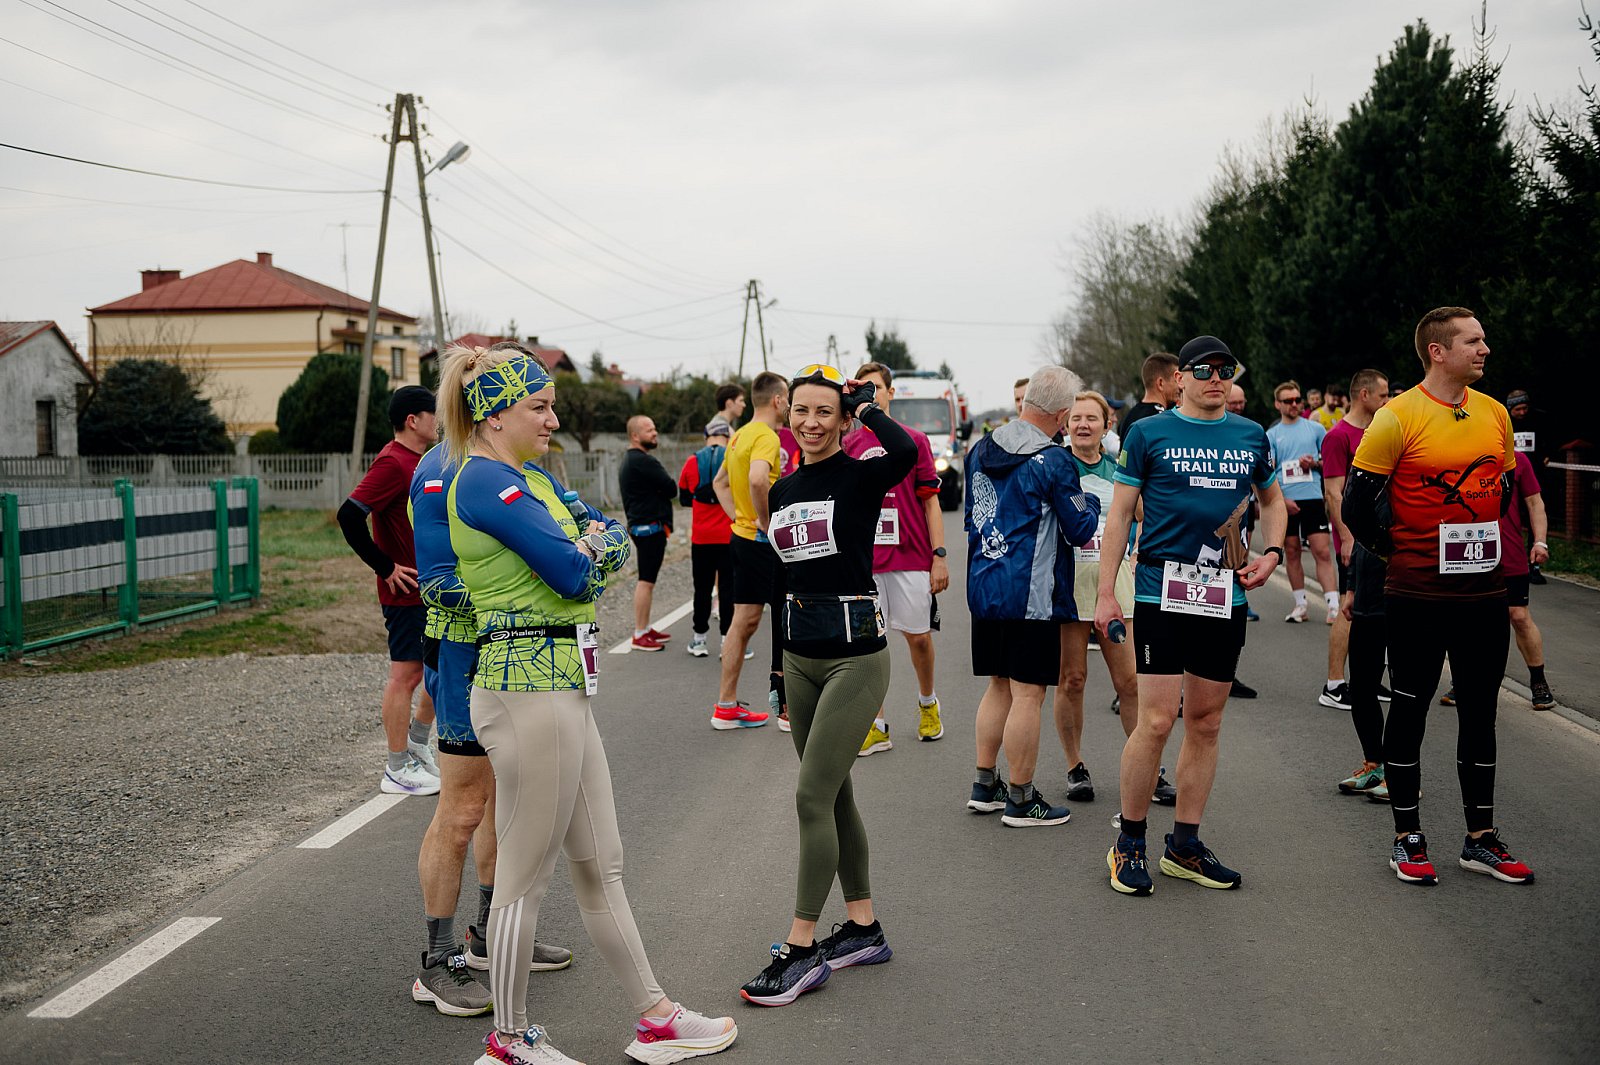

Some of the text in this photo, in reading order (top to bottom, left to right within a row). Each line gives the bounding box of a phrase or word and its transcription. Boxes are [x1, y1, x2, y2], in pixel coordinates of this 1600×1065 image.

[1163, 448, 1218, 460] JULIAN
[1223, 450, 1254, 463] ALPS
[1172, 461, 1249, 475] TRAIL RUN
[1466, 490, 1490, 500] Sport
[790, 524, 808, 546] 18
[1463, 542, 1484, 560] 48
[1186, 583, 1207, 602] 52
[511, 629, 546, 637] Kalenji
[454, 954, 466, 968] 82
